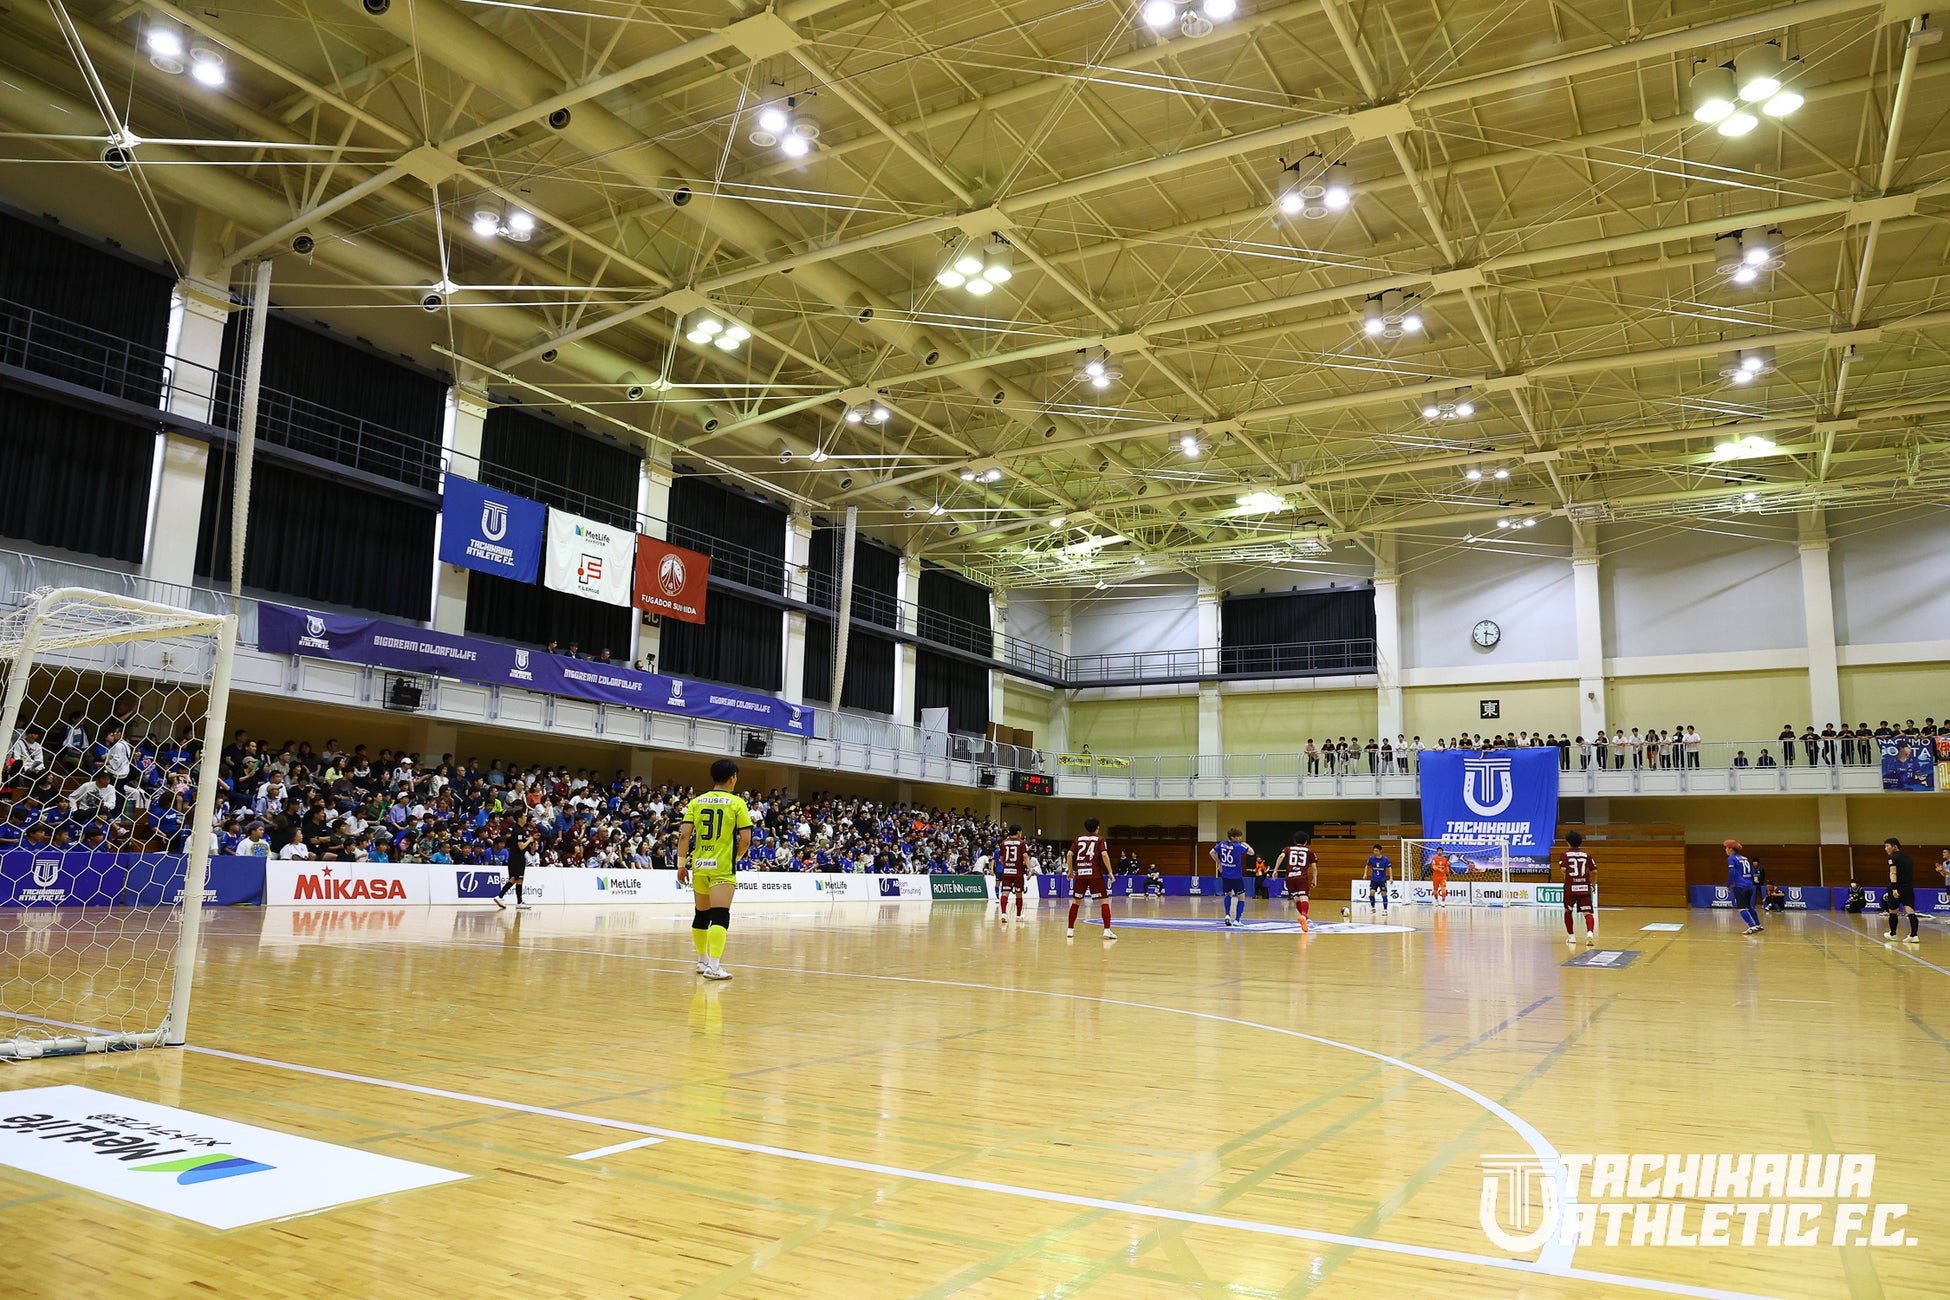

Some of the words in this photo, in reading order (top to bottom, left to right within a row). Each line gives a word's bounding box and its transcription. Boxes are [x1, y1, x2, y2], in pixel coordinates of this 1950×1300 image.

[585, 530, 610, 543] MetLife
[466, 547, 502, 563] ATHLETIC
[470, 539, 513, 557] TACHIKAWA
[641, 594, 672, 607] FUGADOR
[419, 642, 477, 661] COLORFULLIFE
[1482, 702, 1498, 717] 東
[701, 808, 724, 841] 31
[1446, 821, 1530, 834] TACHIKAWA
[1512, 834, 1535, 846] F.C.
[1005, 846, 1018, 862] 13
[1077, 842, 1095, 861] 24
[1221, 848, 1234, 864] 56
[1289, 851, 1307, 866] 63
[1568, 858, 1587, 876] 37
[610, 878, 642, 889] MetLife
[762, 882, 792, 890] 2025-26
[825, 881, 848, 890] MetLife
[933, 883, 953, 893] ROUTE
[964, 885, 982, 893] HOTELS
[1537, 888, 1564, 902] KOTO
[0, 1113, 187, 1162] MetLife
